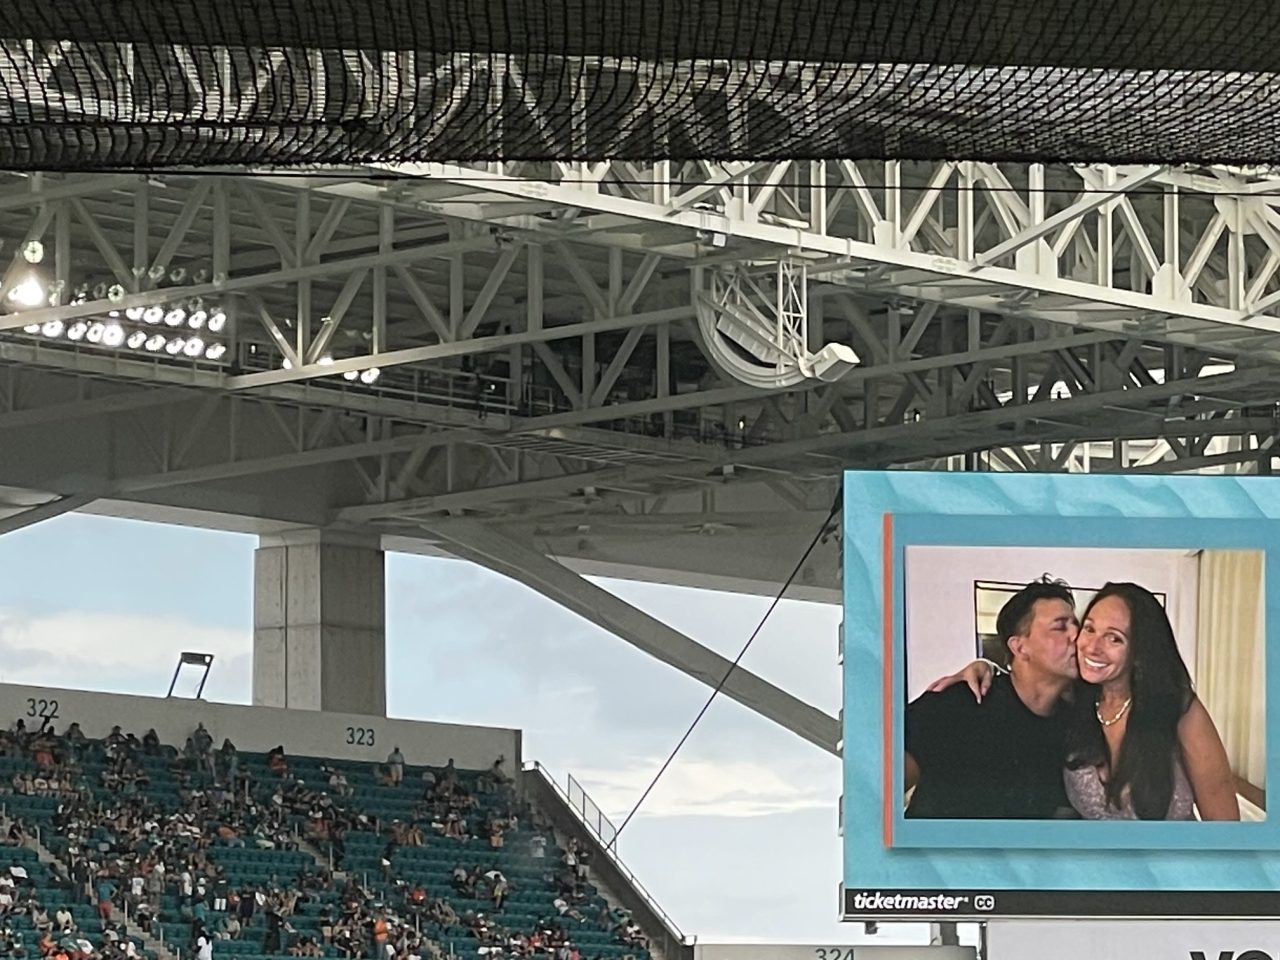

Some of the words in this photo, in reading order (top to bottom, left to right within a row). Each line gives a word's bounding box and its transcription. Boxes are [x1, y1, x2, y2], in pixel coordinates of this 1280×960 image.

[26, 697, 60, 719] 322
[345, 726, 375, 747] 323
[854, 892, 963, 910] ticketmaster
